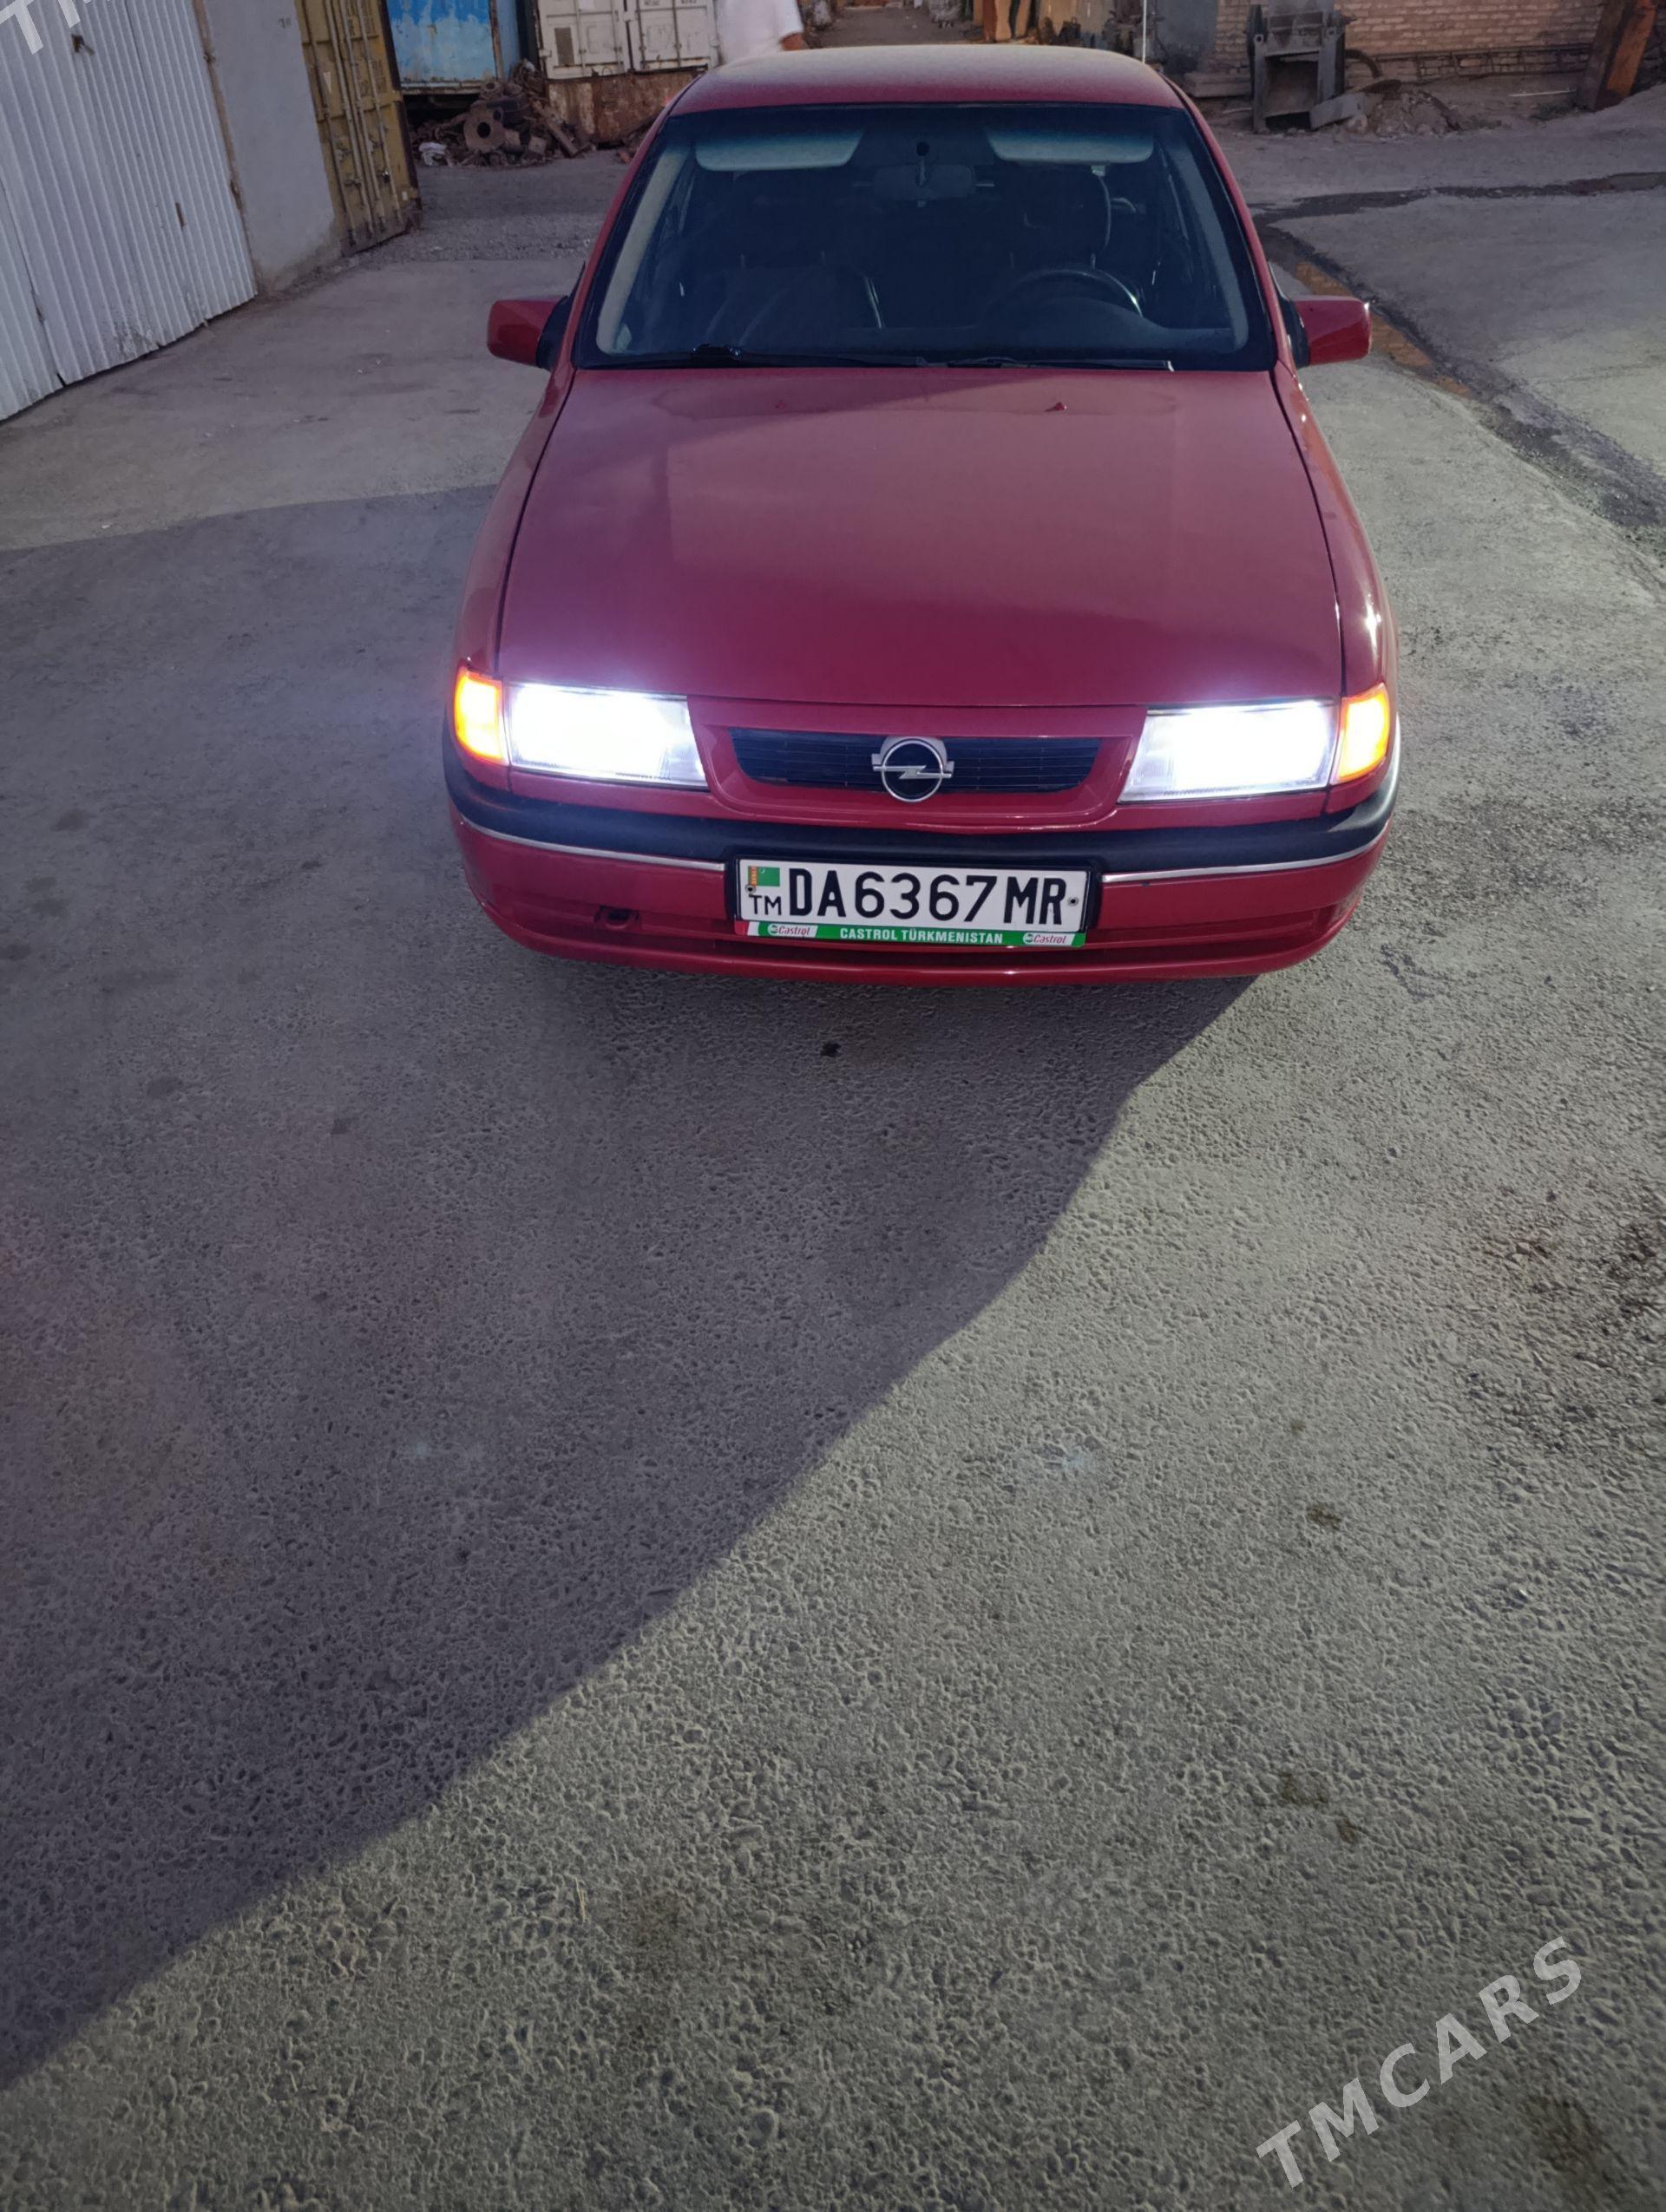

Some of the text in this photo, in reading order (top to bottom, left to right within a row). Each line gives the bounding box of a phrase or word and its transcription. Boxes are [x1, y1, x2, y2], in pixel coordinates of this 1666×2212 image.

[748, 894, 782, 915] TM
[788, 867, 1067, 926] DA6367MR
[777, 926, 810, 936] Castrol
[840, 927, 1002, 944] CASTROL TÜRKMENISTAN
[1033, 934, 1068, 945] Castrol
